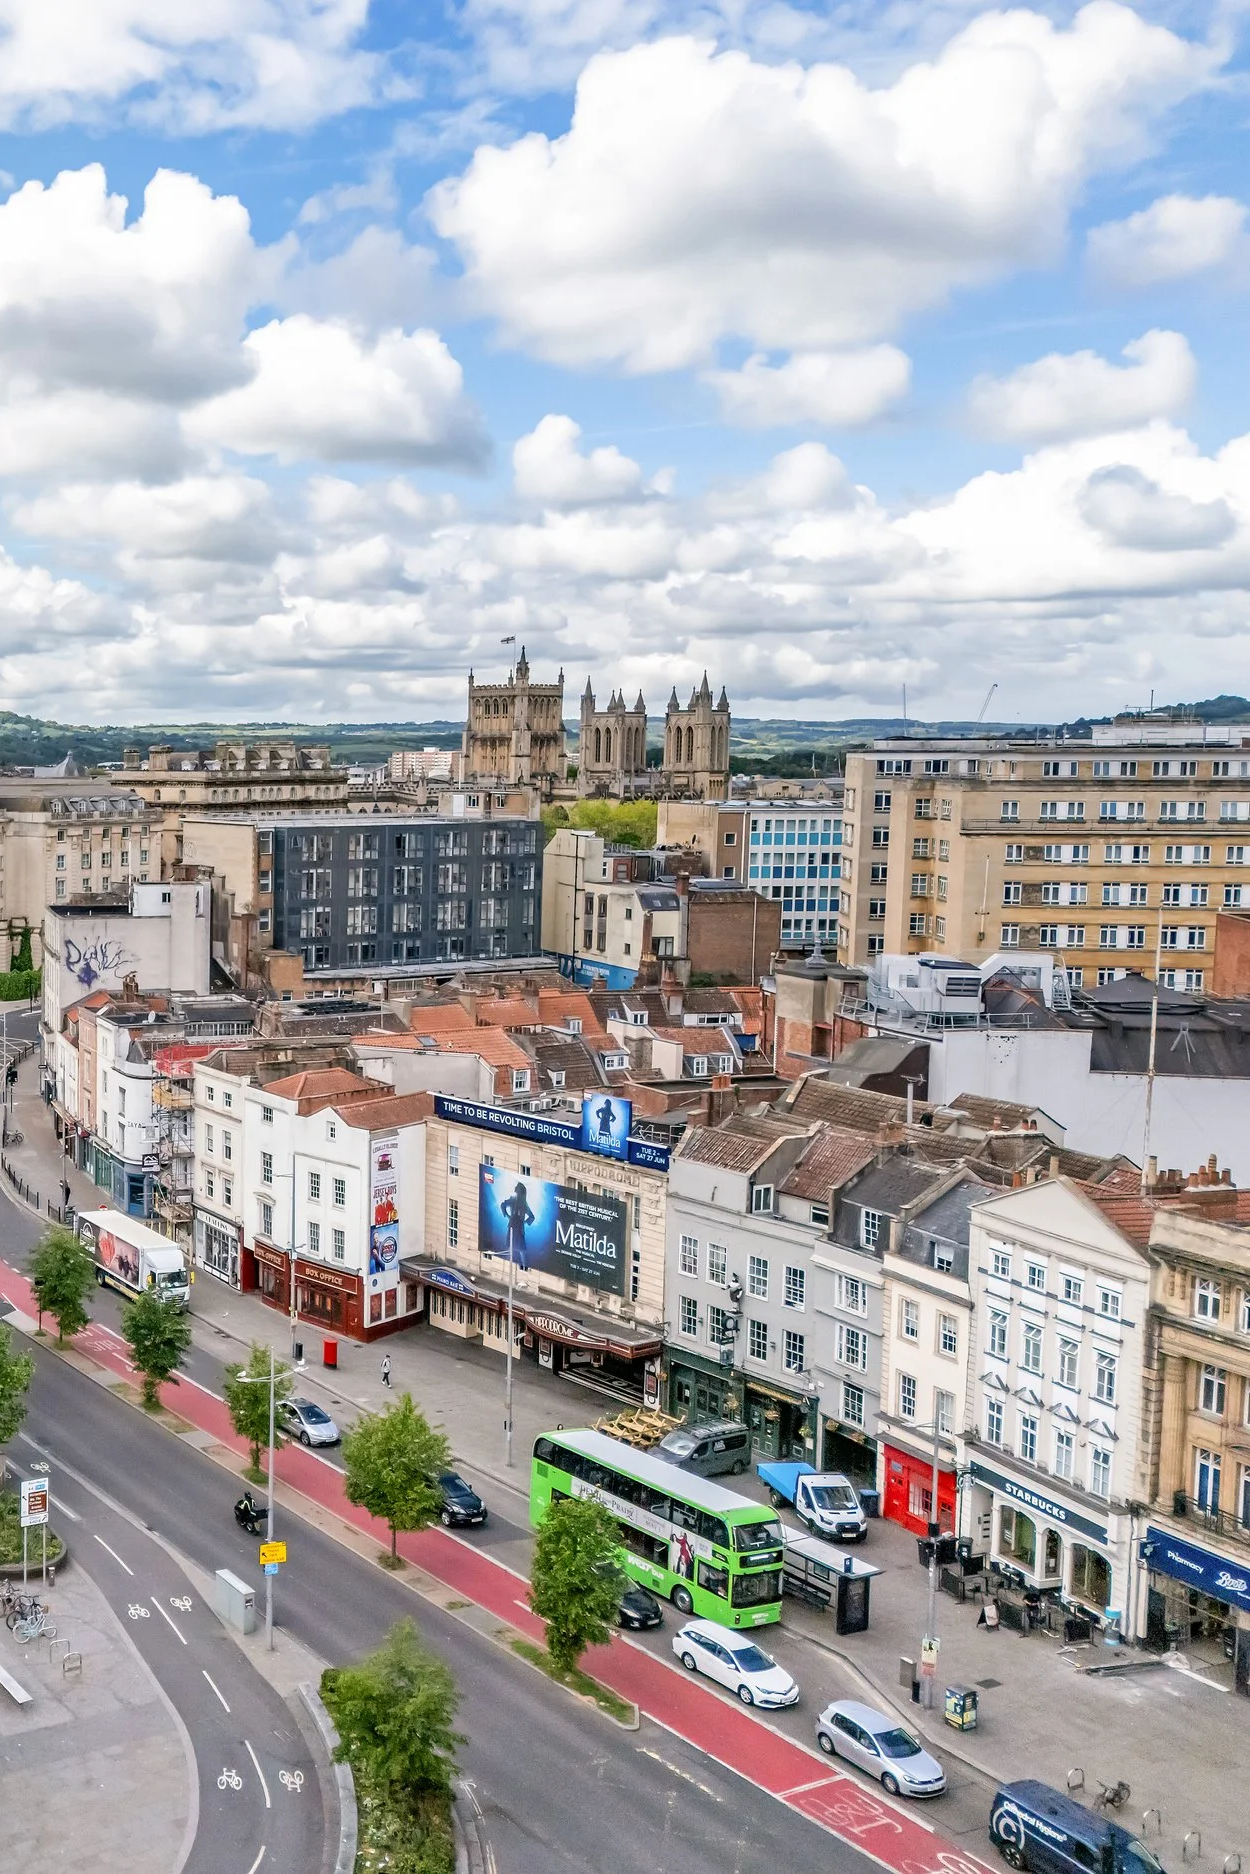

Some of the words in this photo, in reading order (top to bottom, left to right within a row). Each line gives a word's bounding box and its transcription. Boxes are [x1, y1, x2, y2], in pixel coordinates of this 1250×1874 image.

[443, 1102, 462, 1114] TIME
[464, 1106, 474, 1116] TO
[477, 1109, 487, 1120] BE
[489, 1112, 535, 1130] REVOLTING
[538, 1123, 574, 1140] BRISTOL
[589, 1129, 620, 1148] Matilda
[654, 1156, 665, 1164] JUN
[570, 1160, 639, 1187] HIPPODROME
[579, 1202, 596, 1211] BRITISH
[597, 1208, 618, 1218] MUSICAL
[555, 1220, 616, 1258] Matilda
[265, 1252, 281, 1265] OFFICE
[306, 1268, 319, 1278] BOX
[320, 1272, 342, 1286] OFFICE
[1005, 1483, 1066, 1520] STARBUCKS
[1168, 1550, 1204, 1574] Pharmacy
[1215, 1572, 1247, 1591] Boots
[1004, 1801, 1035, 1826] Cathedral
